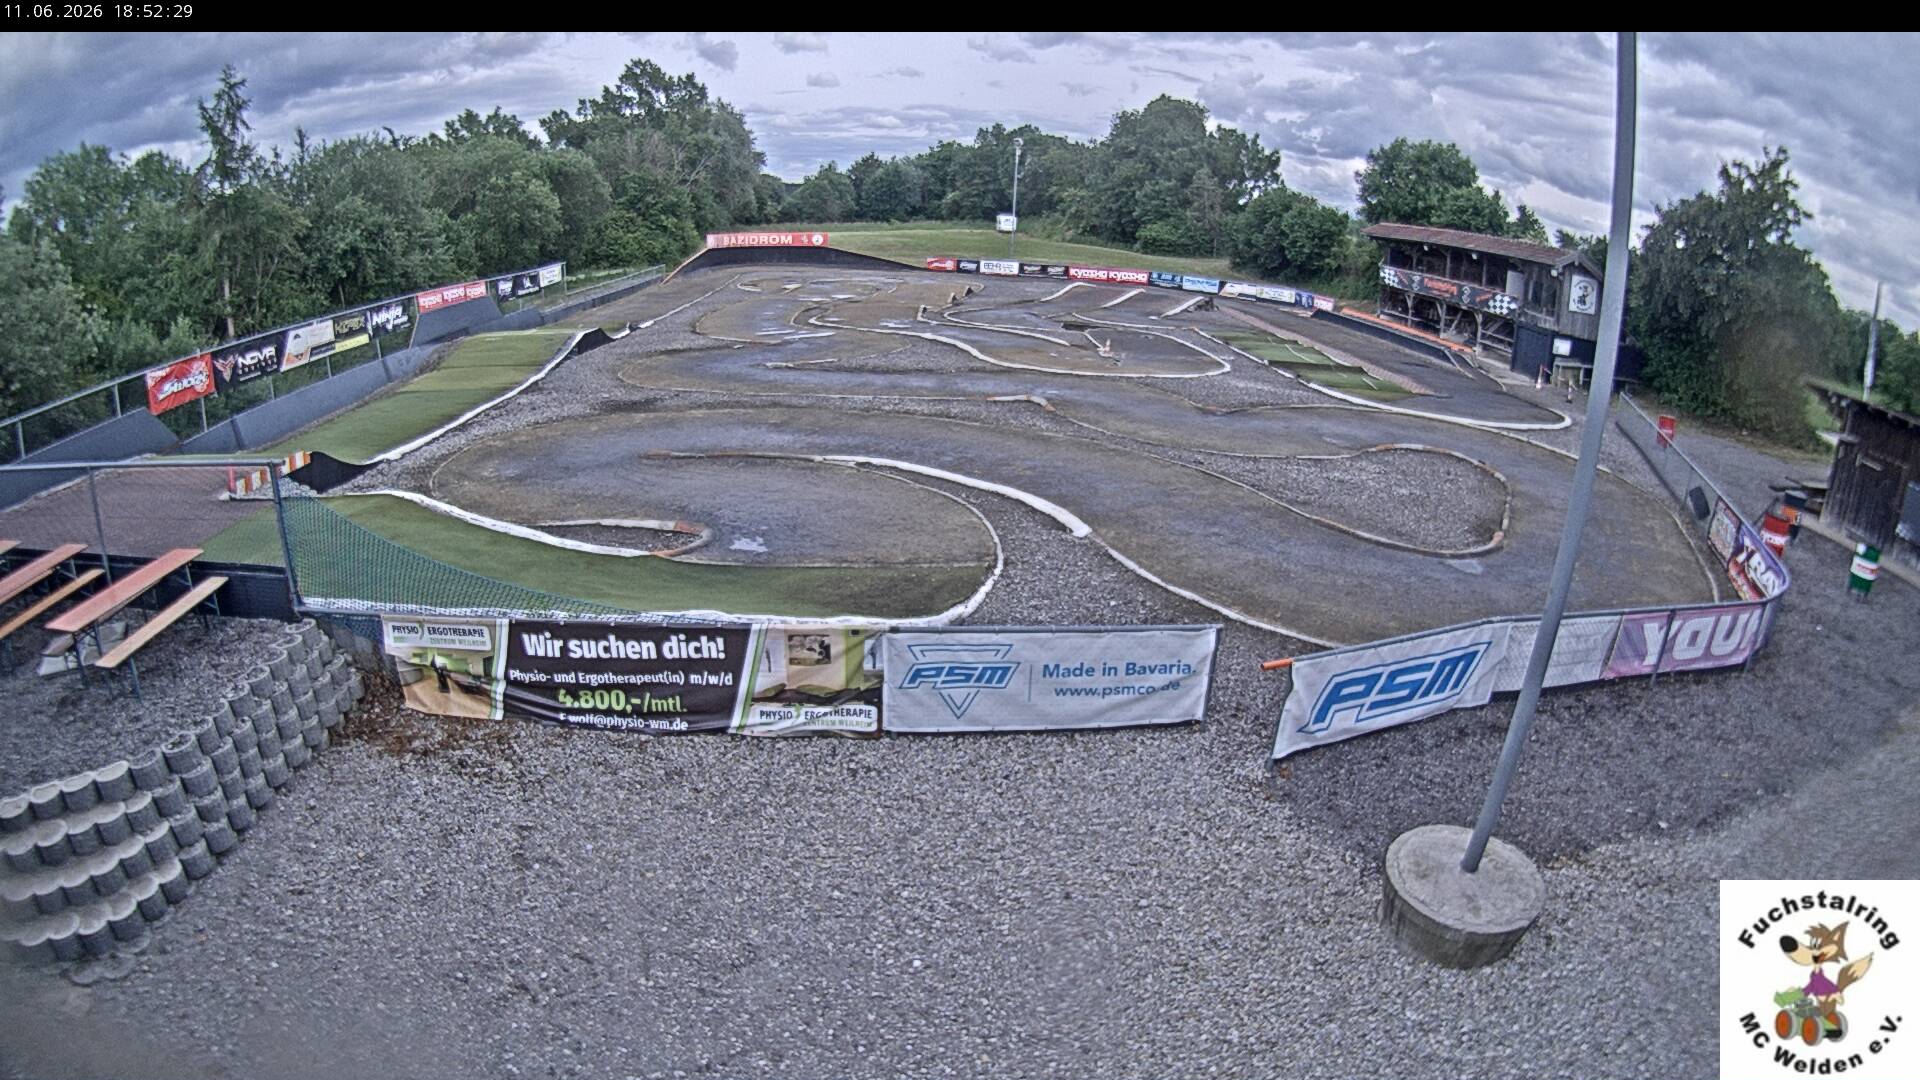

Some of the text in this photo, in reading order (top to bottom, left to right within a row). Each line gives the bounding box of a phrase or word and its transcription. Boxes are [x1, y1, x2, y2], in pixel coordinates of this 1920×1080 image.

[391, 624, 485, 638] PHYSIO ERGOTHERAPIE
[522, 632, 726, 659] Wir suchen dich!
[510, 669, 733, 687] Physio- und Ergotherapeut(in) m/w/d
[907, 665, 1012, 686] PSM
[1042, 660, 1197, 679] Made in Bavaria.
[1311, 649, 1482, 725] PSM
[759, 709, 793, 721] PHYSIO
